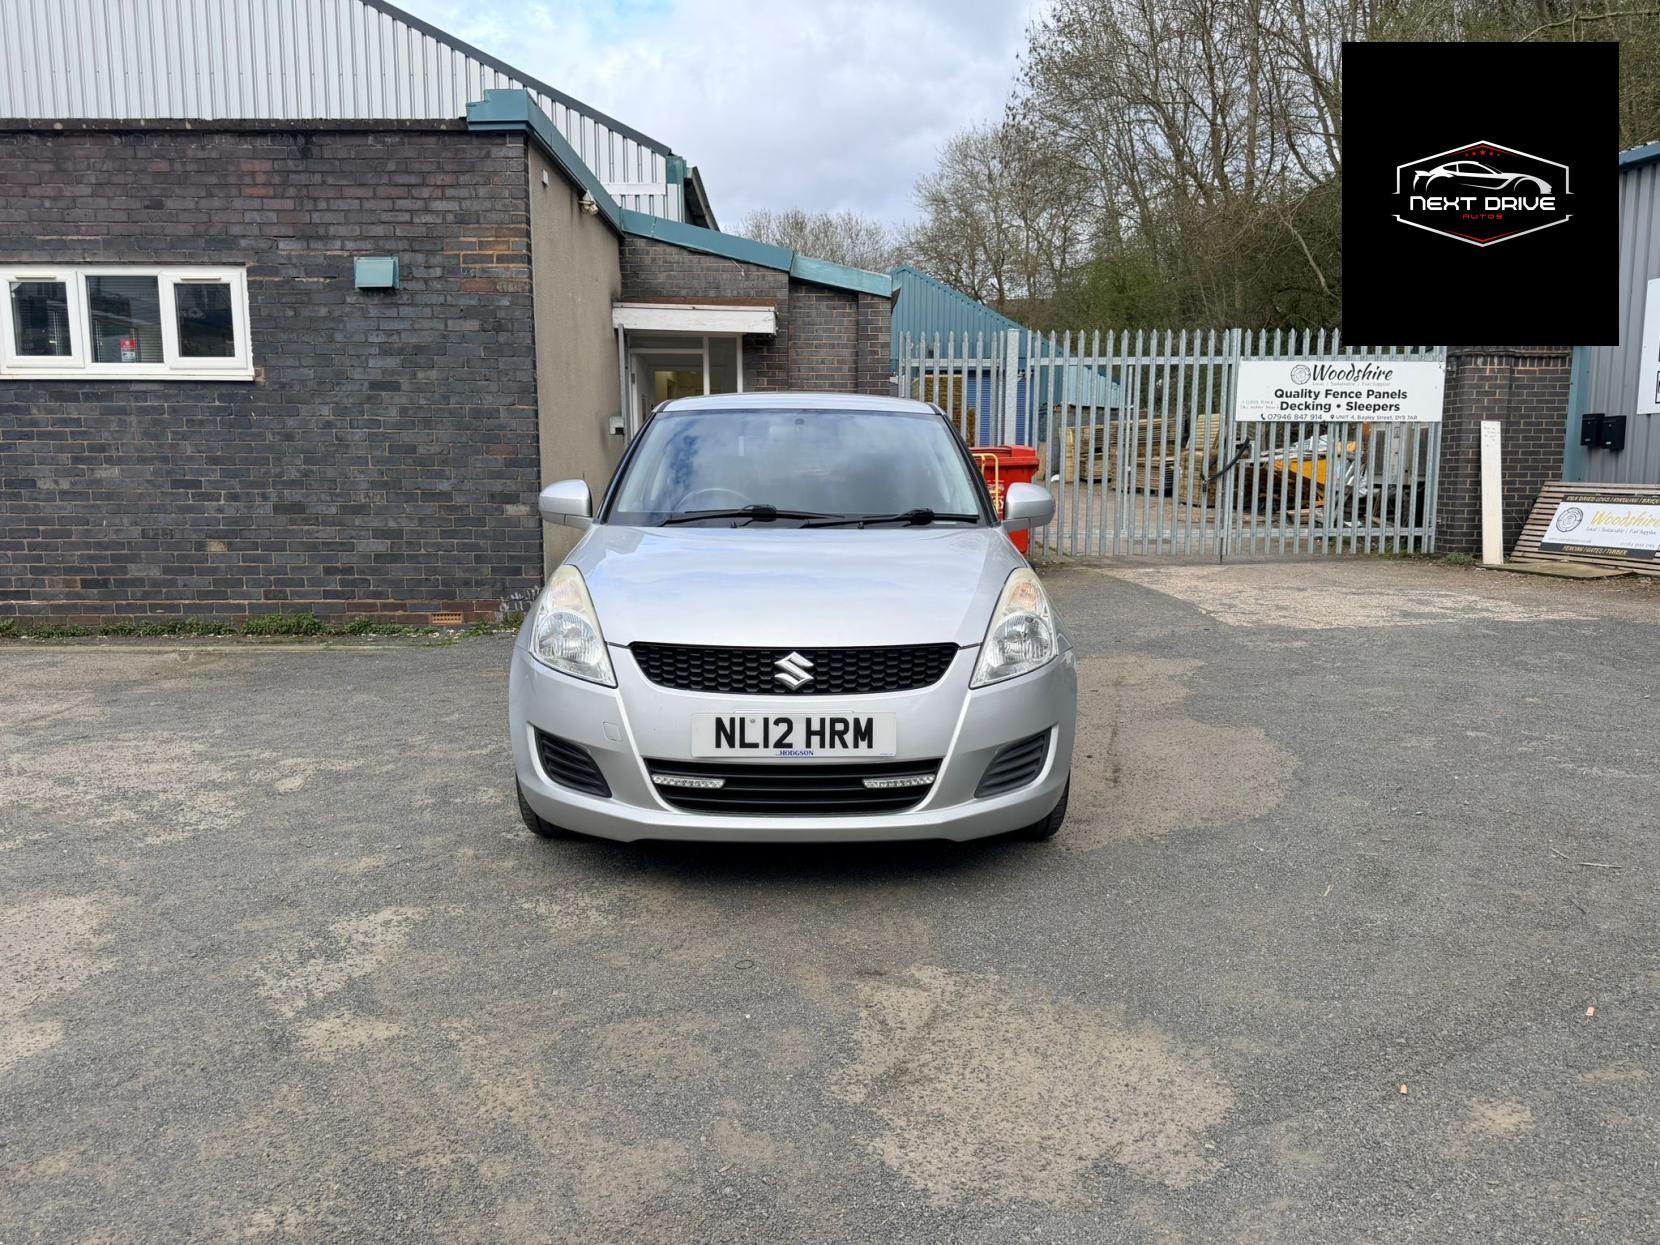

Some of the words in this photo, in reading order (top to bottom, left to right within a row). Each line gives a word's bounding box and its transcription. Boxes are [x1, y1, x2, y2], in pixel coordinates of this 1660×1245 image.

[1312, 363, 1393, 382] Woodshire
[1274, 388, 1321, 400] Quality
[1325, 389, 1362, 399] Fence
[1367, 389, 1407, 399] Panels
[1280, 401, 1332, 413] Decking
[1346, 401, 1400, 413] Sleepers
[1590, 511, 1660, 528] Woodshire
[715, 716, 794, 749] NL12
[805, 717, 874, 749] HRM
